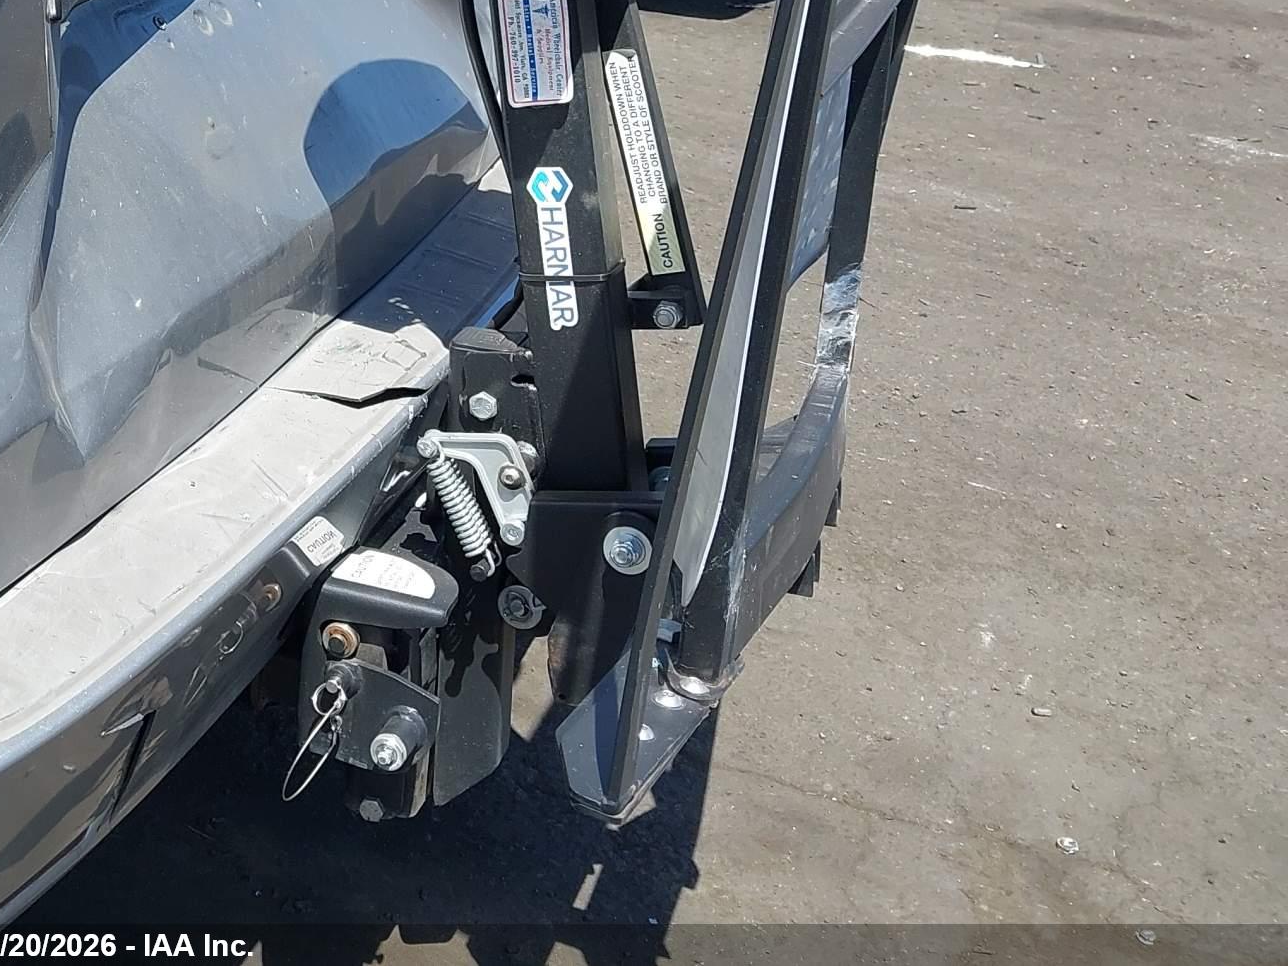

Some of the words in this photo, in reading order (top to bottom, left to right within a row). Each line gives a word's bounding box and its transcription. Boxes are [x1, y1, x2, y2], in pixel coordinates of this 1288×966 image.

[552, 33, 562, 70] Wheelchair
[555, 73, 564, 97] Center
[609, 61, 622, 91] WHEN
[619, 65, 638, 118] DIFFERENT
[628, 55, 645, 103] SCOOTER
[616, 93, 635, 150] HOLDDOWN
[632, 119, 641, 128] A
[638, 104, 648, 117] OF
[634, 129, 644, 144] TO
[642, 120, 656, 151] STYLE
[639, 145, 656, 197] CHANGING
[649, 152, 660, 167] OR
[629, 153, 648, 204] READJUST
[653, 170, 668, 204] BRAND
[652, 213, 673, 268] CAUTION
